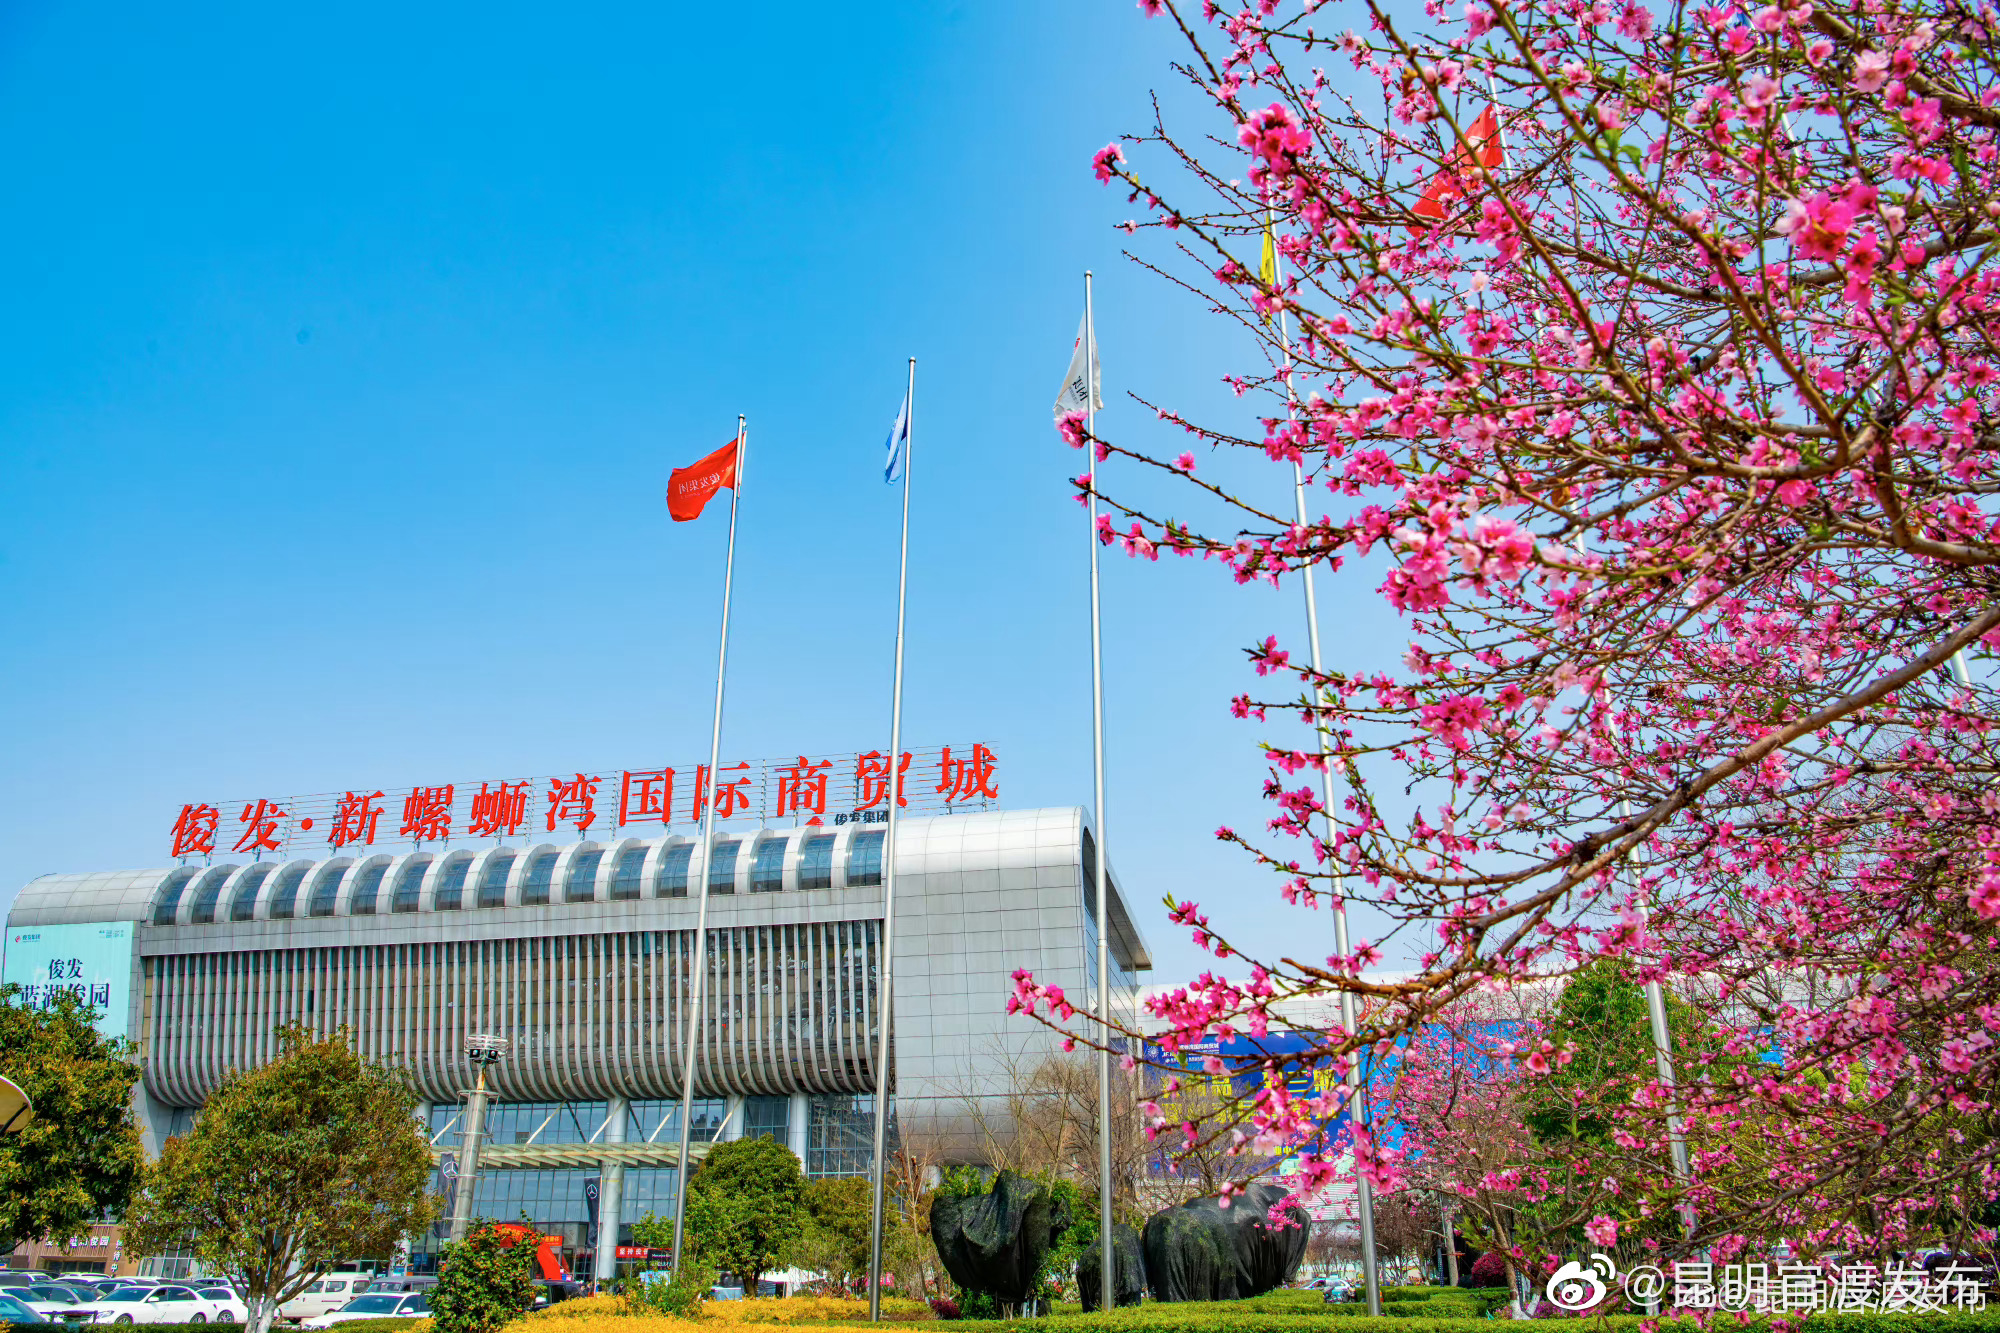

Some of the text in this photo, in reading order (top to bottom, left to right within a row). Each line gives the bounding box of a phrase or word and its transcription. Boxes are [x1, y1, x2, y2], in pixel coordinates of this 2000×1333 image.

[171, 743, 999, 857] 俊发·新螺蛳湾国际商贸城
[48, 958, 84, 980] 俊发
